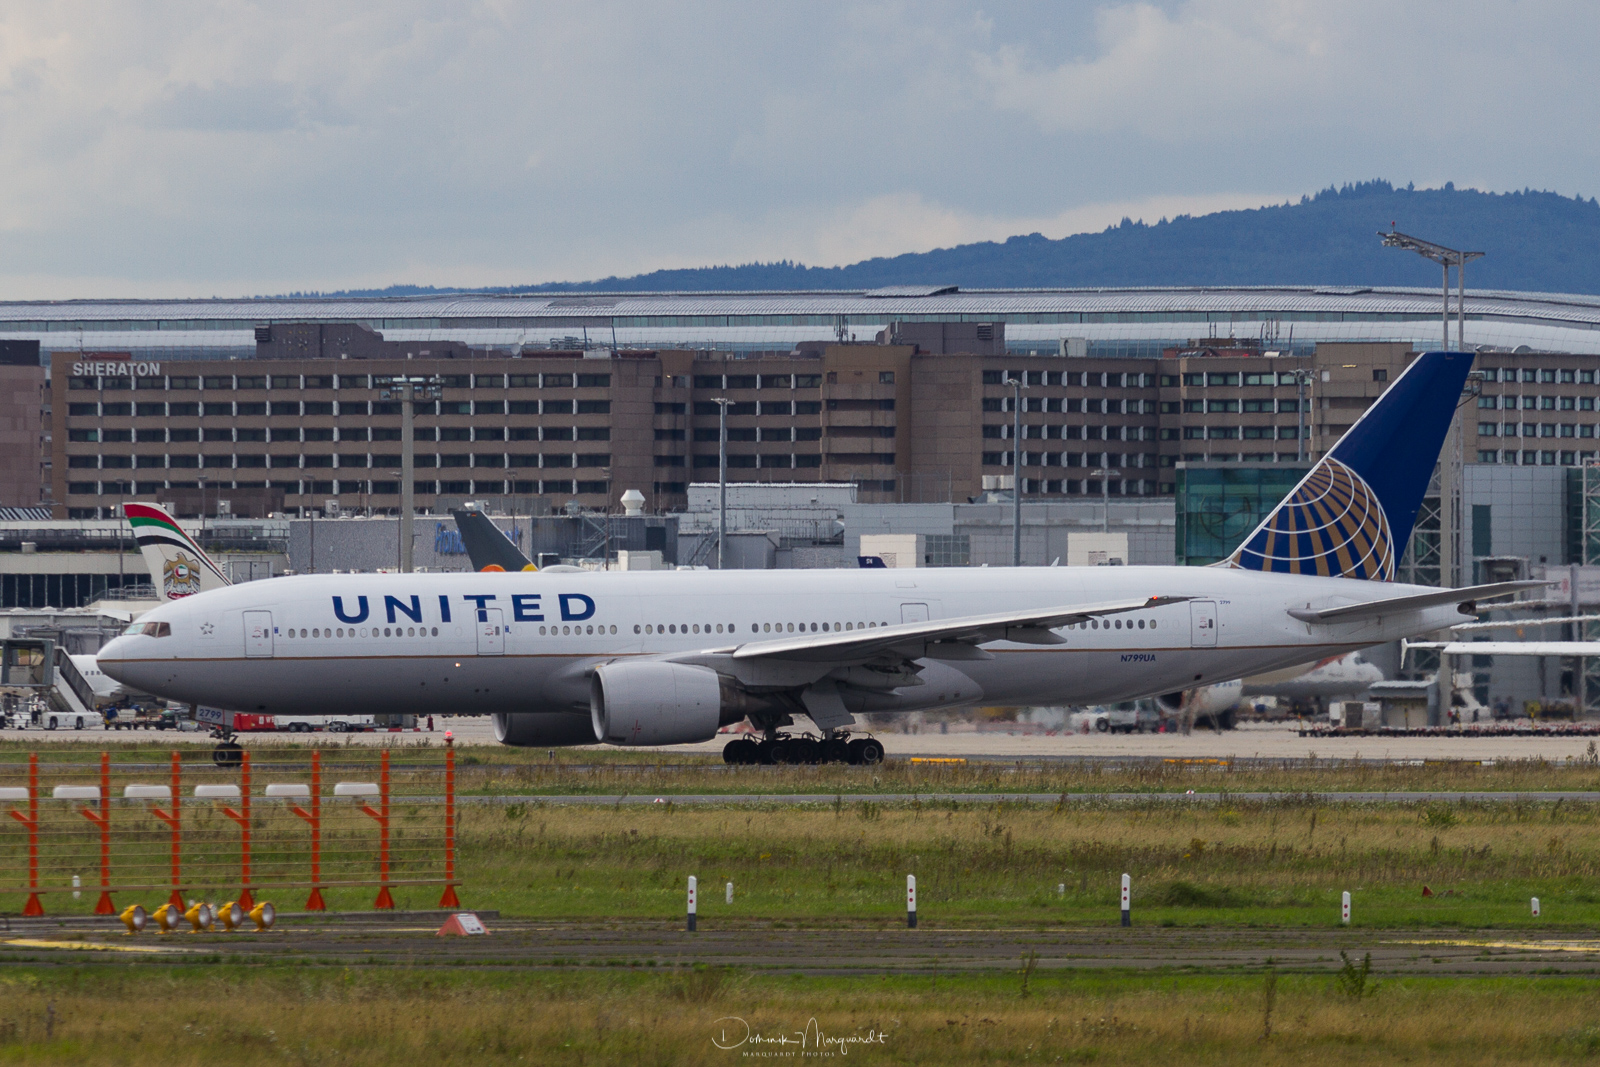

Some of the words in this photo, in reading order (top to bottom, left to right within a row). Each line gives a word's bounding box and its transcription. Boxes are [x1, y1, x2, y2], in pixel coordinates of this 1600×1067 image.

[73, 362, 160, 376] SHERATON
[332, 593, 596, 624] UNITED
[1120, 654, 1156, 662] N799UA
[199, 708, 222, 720] 2799
